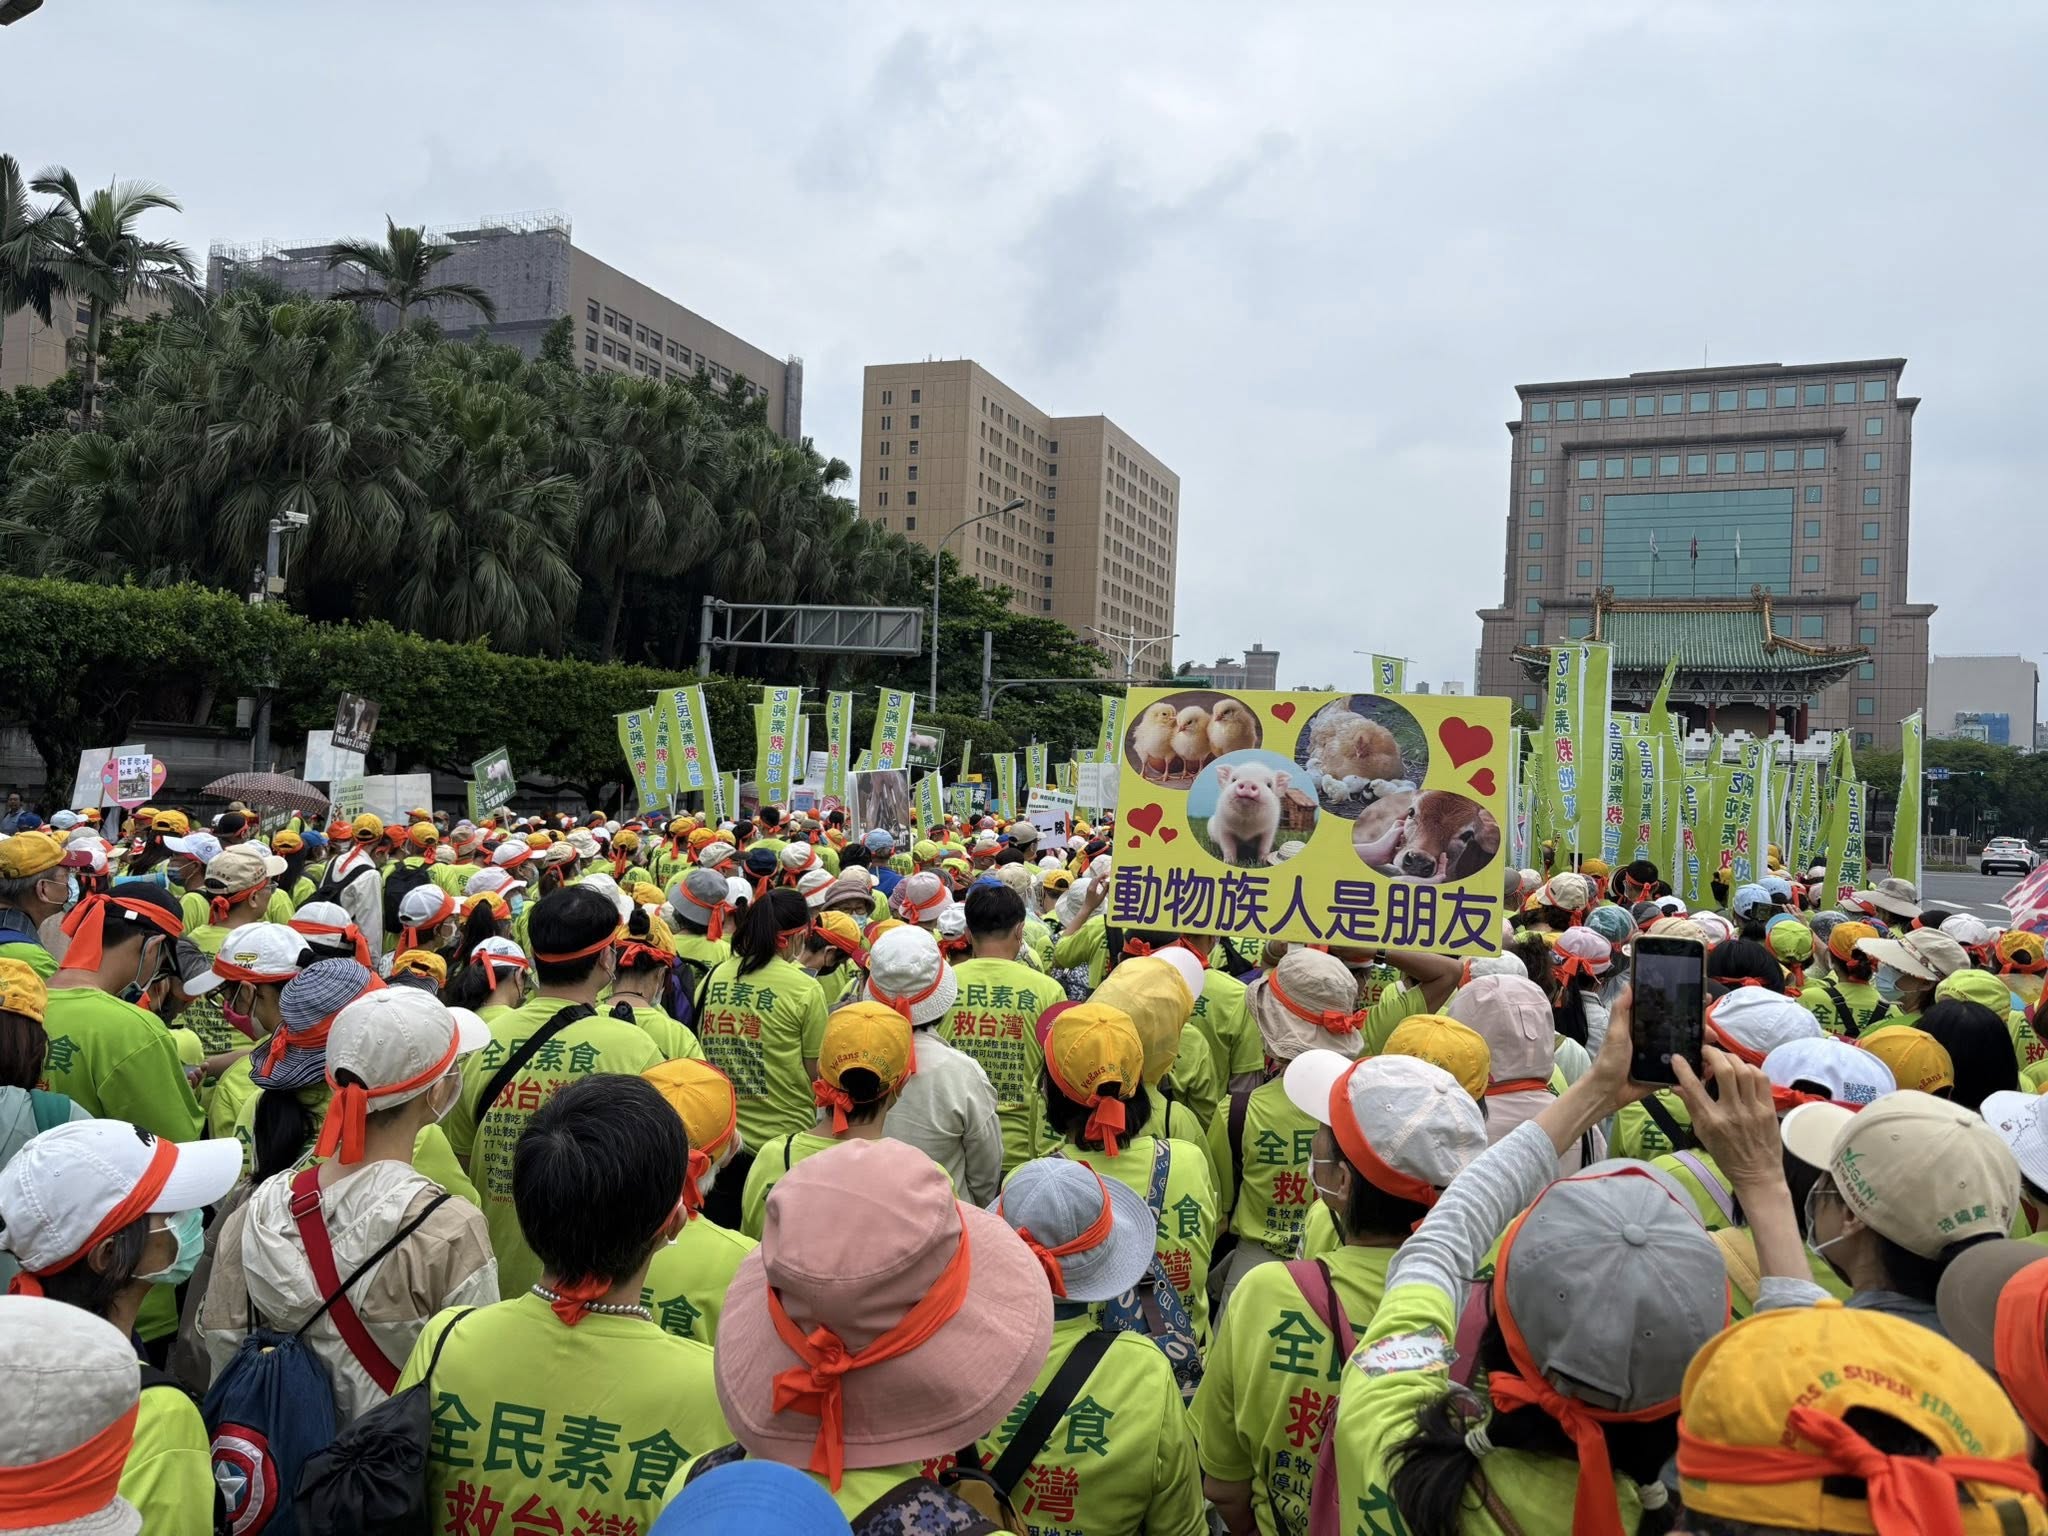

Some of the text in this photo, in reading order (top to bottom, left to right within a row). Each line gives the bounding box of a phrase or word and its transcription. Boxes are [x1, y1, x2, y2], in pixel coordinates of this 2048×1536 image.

[1111, 865, 1498, 952] 動物族人是朋友
[704, 981, 777, 1013] 民素食
[703, 1009, 762, 1040] 救台灣
[953, 1010, 1025, 1040] 救台灣
[1812, 1003, 1895, 1030] 全民素
[1268, 1309, 1341, 1382] 全
[1376, 1345, 1434, 1363] VEGAN
[1818, 1370, 1841, 1389] R
[1843, 1365, 1915, 1400] SUPER
[1285, 1387, 1340, 1455] 救
[430, 1391, 692, 1500] 全民素食
